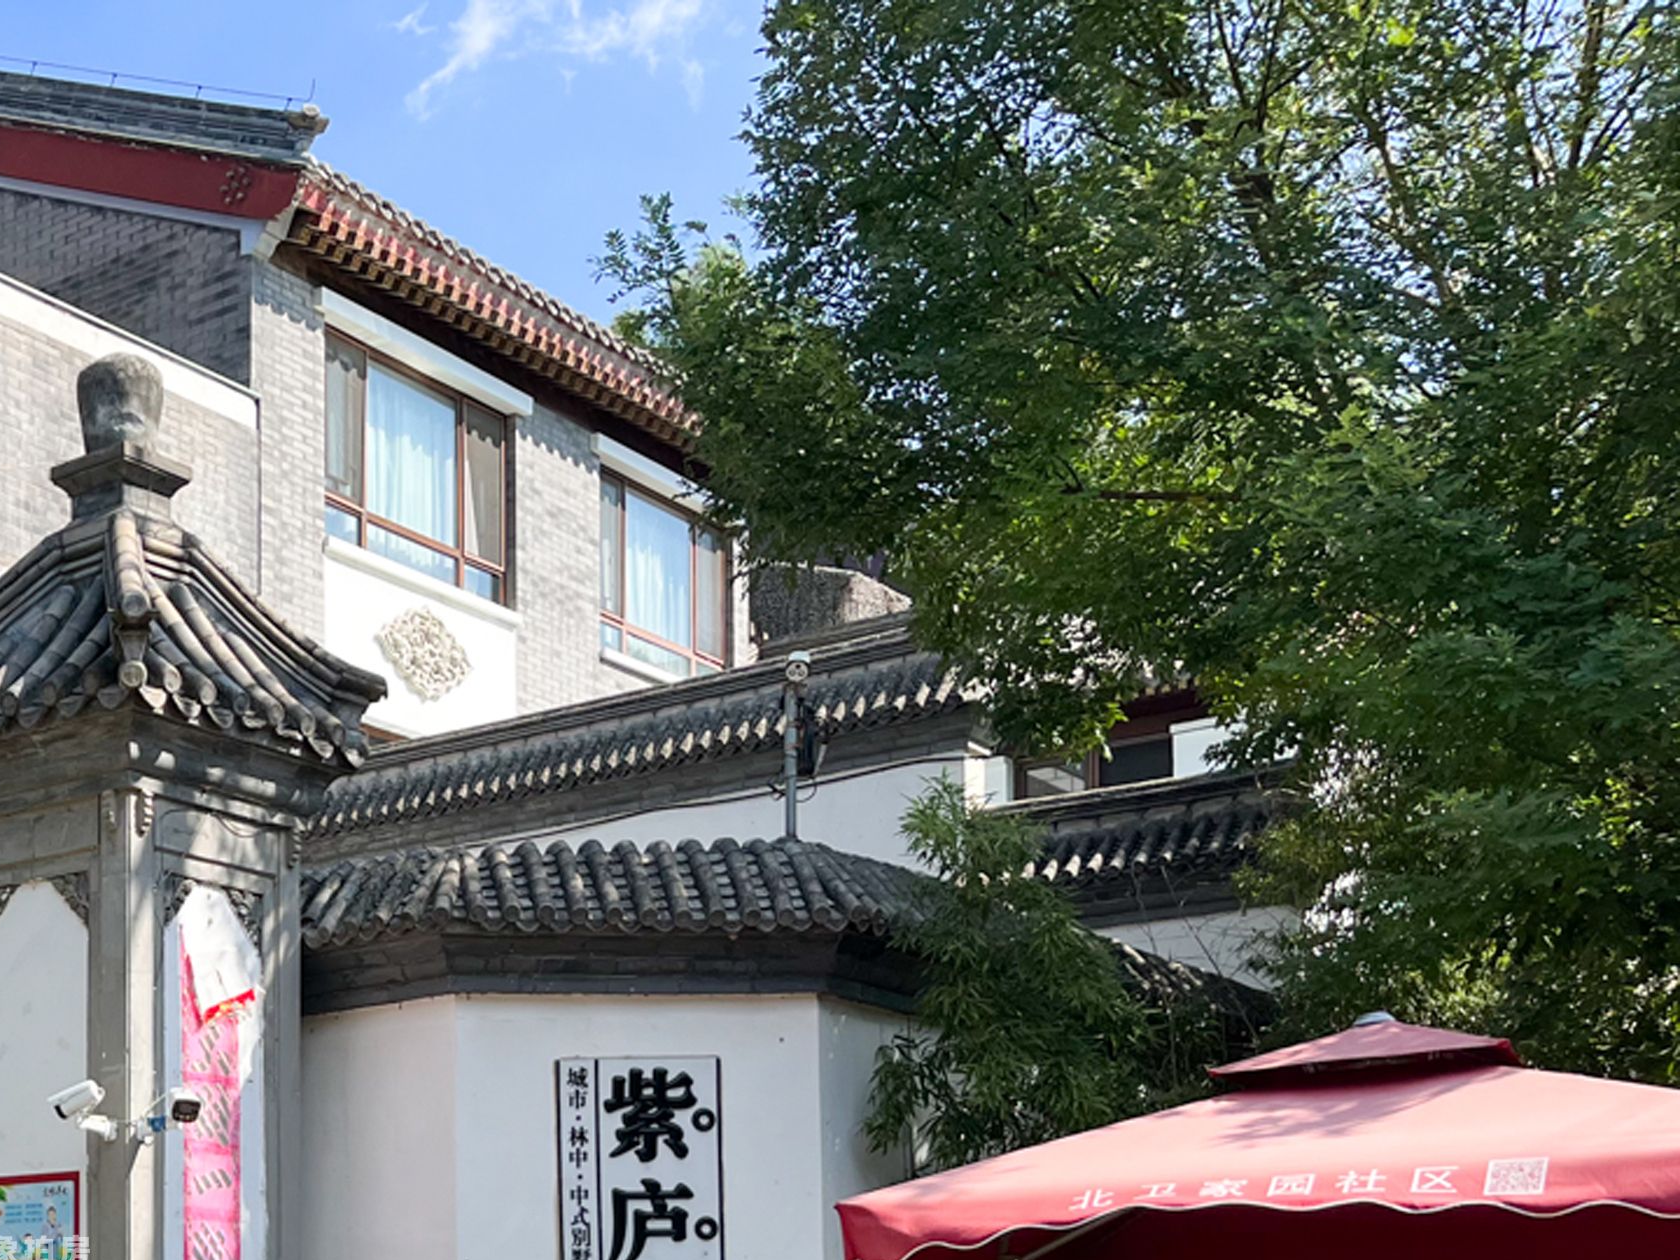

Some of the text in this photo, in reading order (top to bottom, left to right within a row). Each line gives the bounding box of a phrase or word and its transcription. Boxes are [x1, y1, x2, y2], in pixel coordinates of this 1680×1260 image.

[1070, 1166, 1458, 1209] 北卫家园社区
